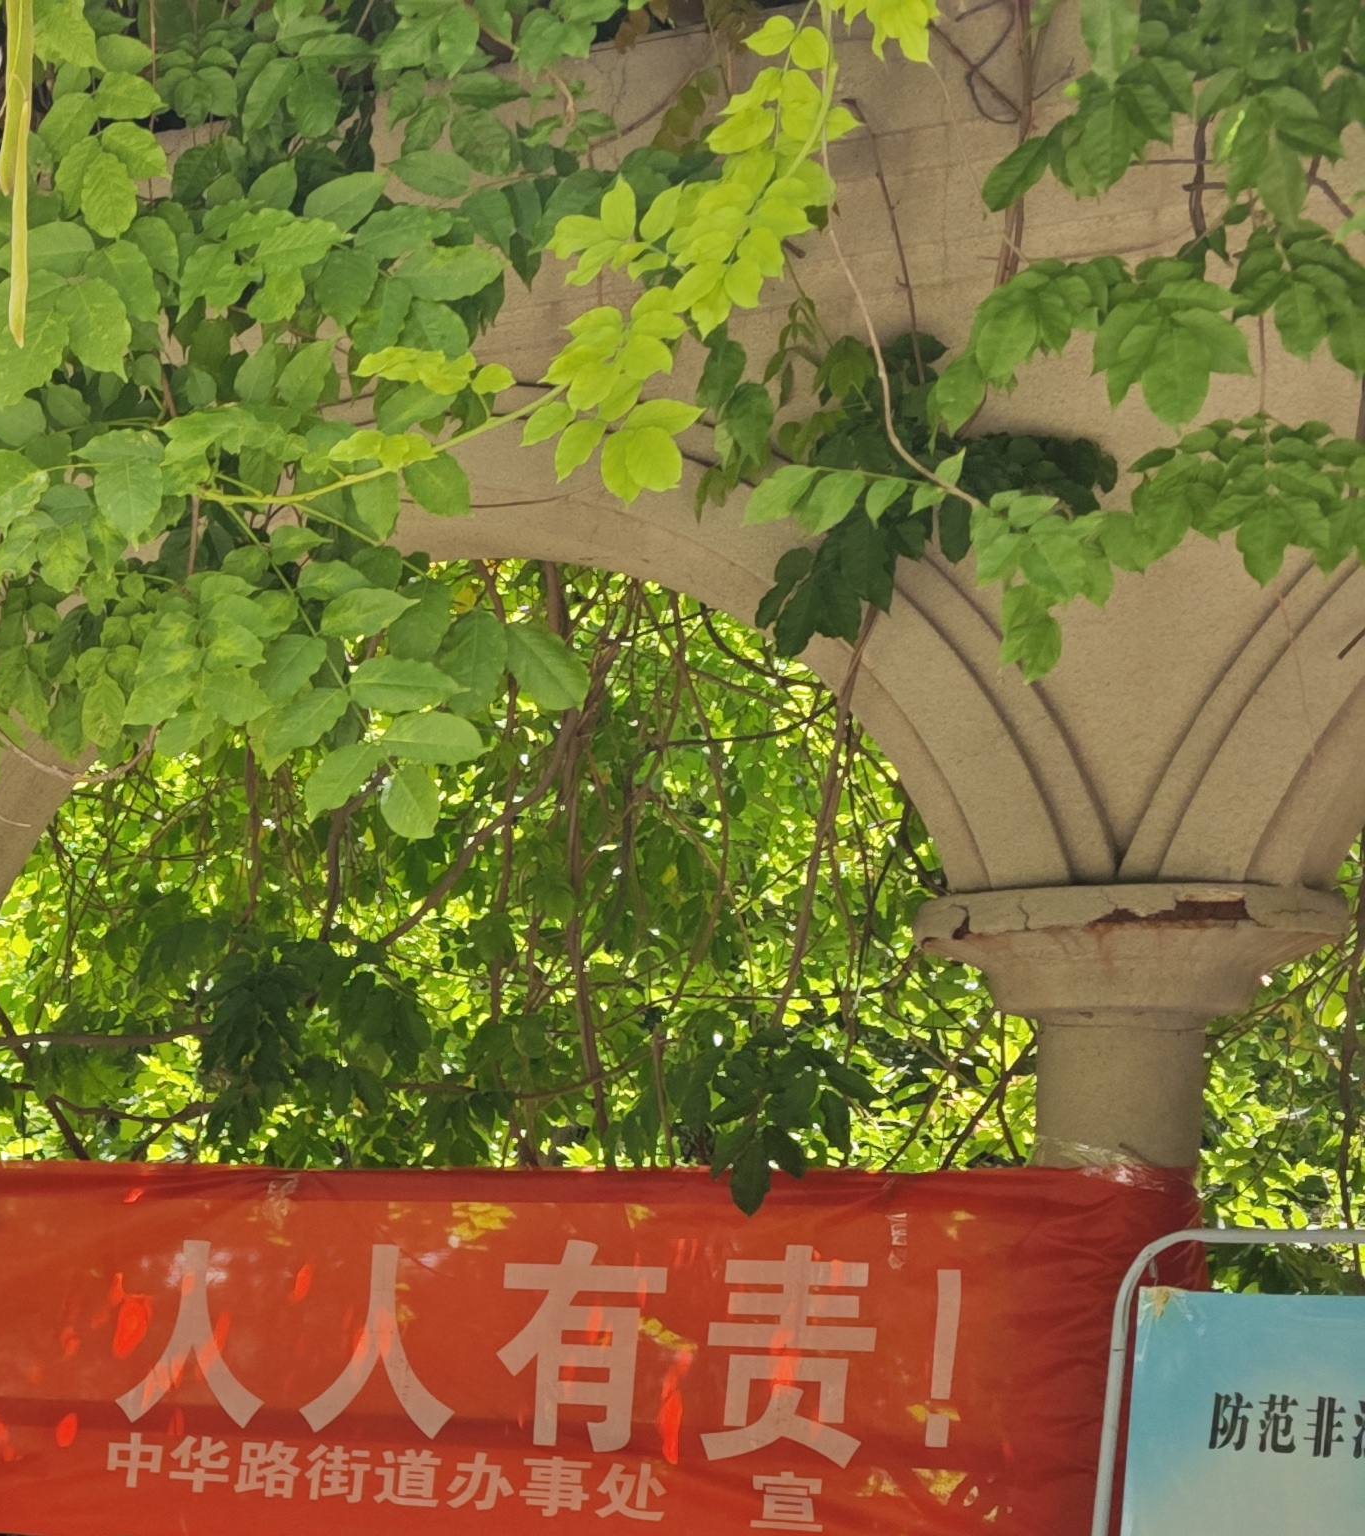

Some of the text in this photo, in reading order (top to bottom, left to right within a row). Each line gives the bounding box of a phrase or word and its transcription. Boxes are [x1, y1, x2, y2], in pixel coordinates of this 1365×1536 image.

[1208, 1391, 1365, 1460] 防范非
[105, 1432, 825, 1535] 中华路街道办事处 宣
